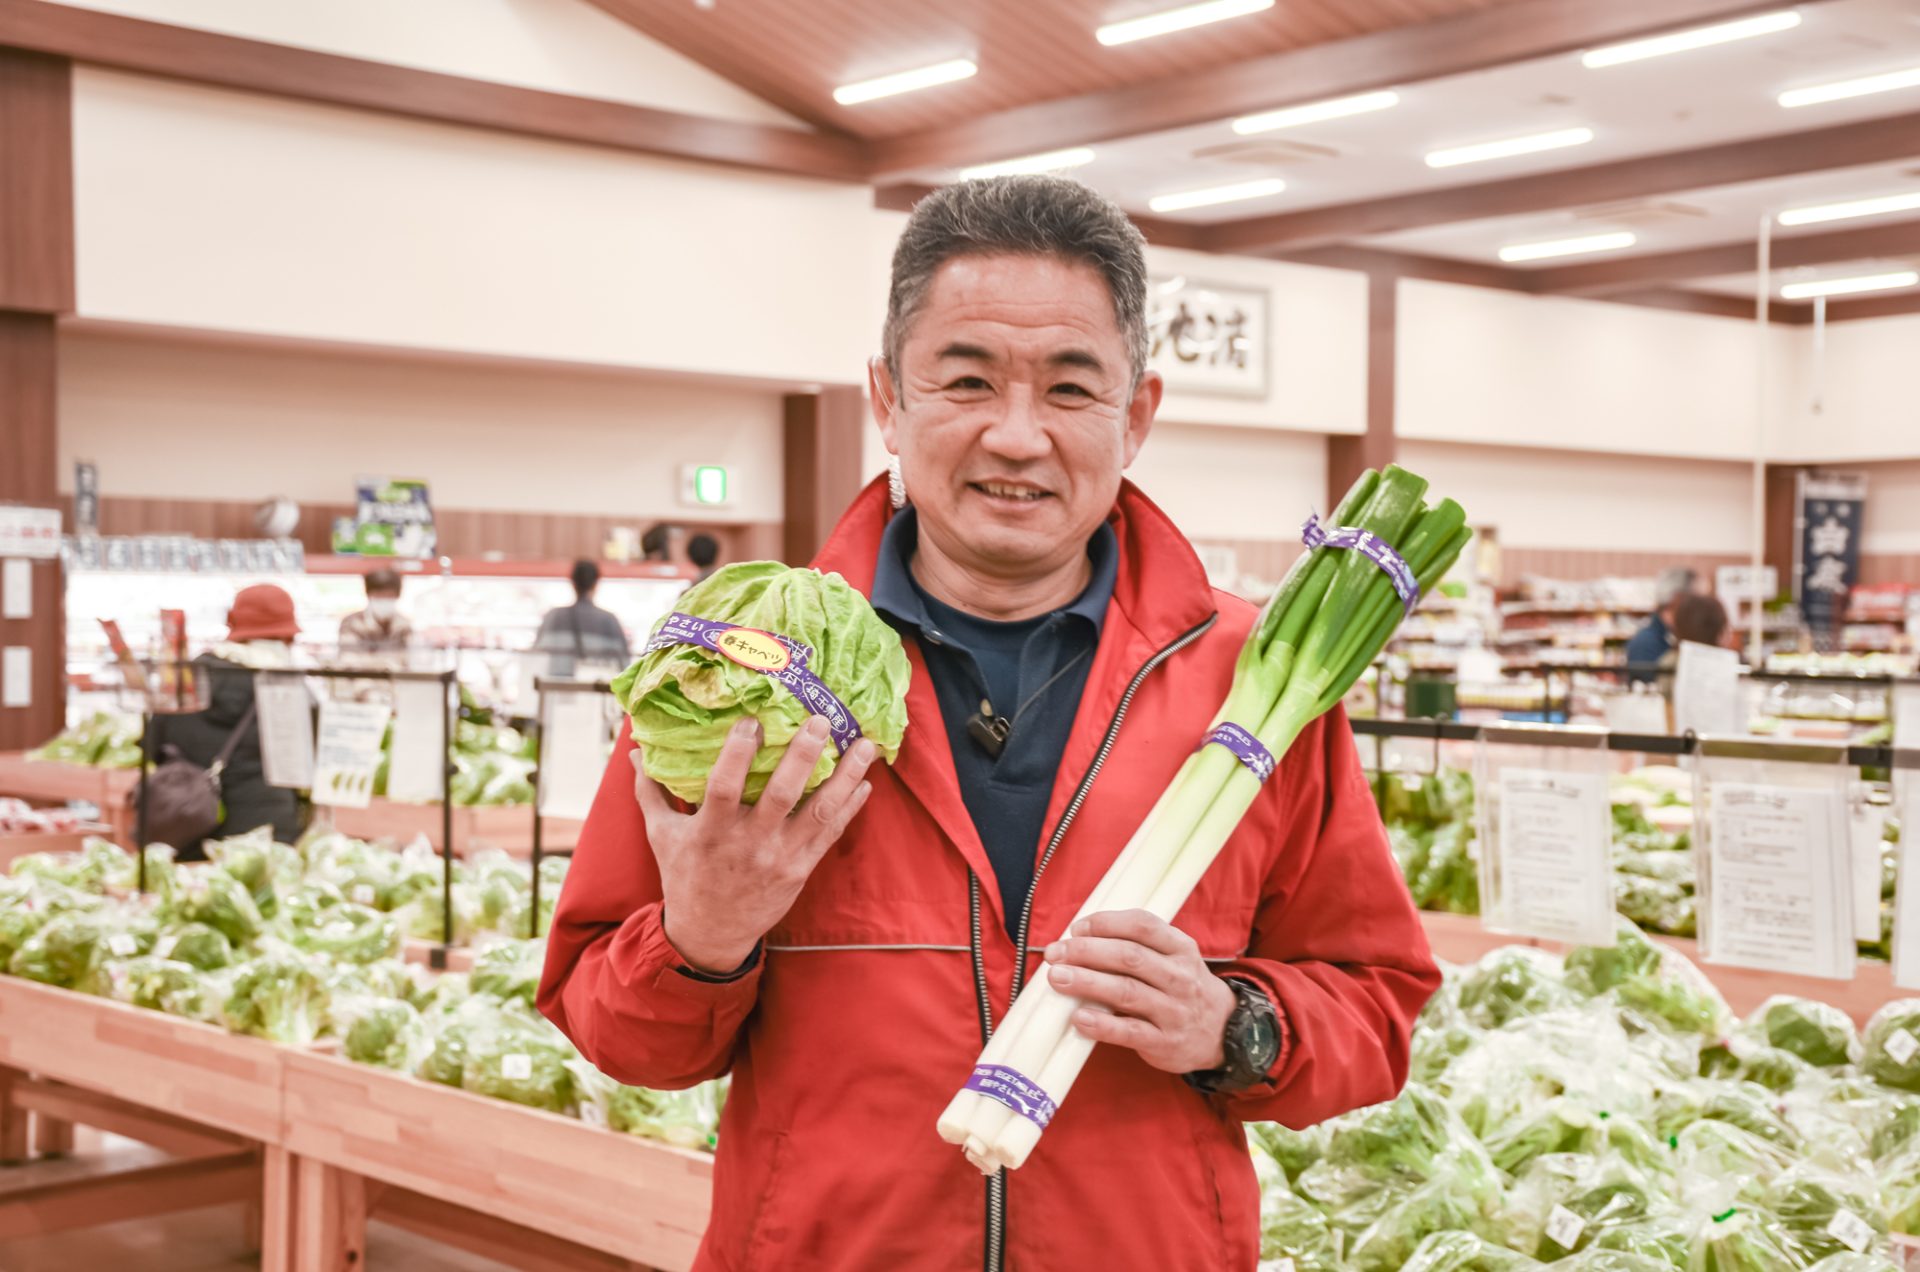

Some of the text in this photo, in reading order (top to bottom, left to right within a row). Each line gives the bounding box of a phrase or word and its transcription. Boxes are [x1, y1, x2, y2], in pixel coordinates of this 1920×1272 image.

[668, 615, 704, 632] やさい
[723, 634, 784, 665] 春キャベツ
[805, 685, 846, 730] 埼玉県産
